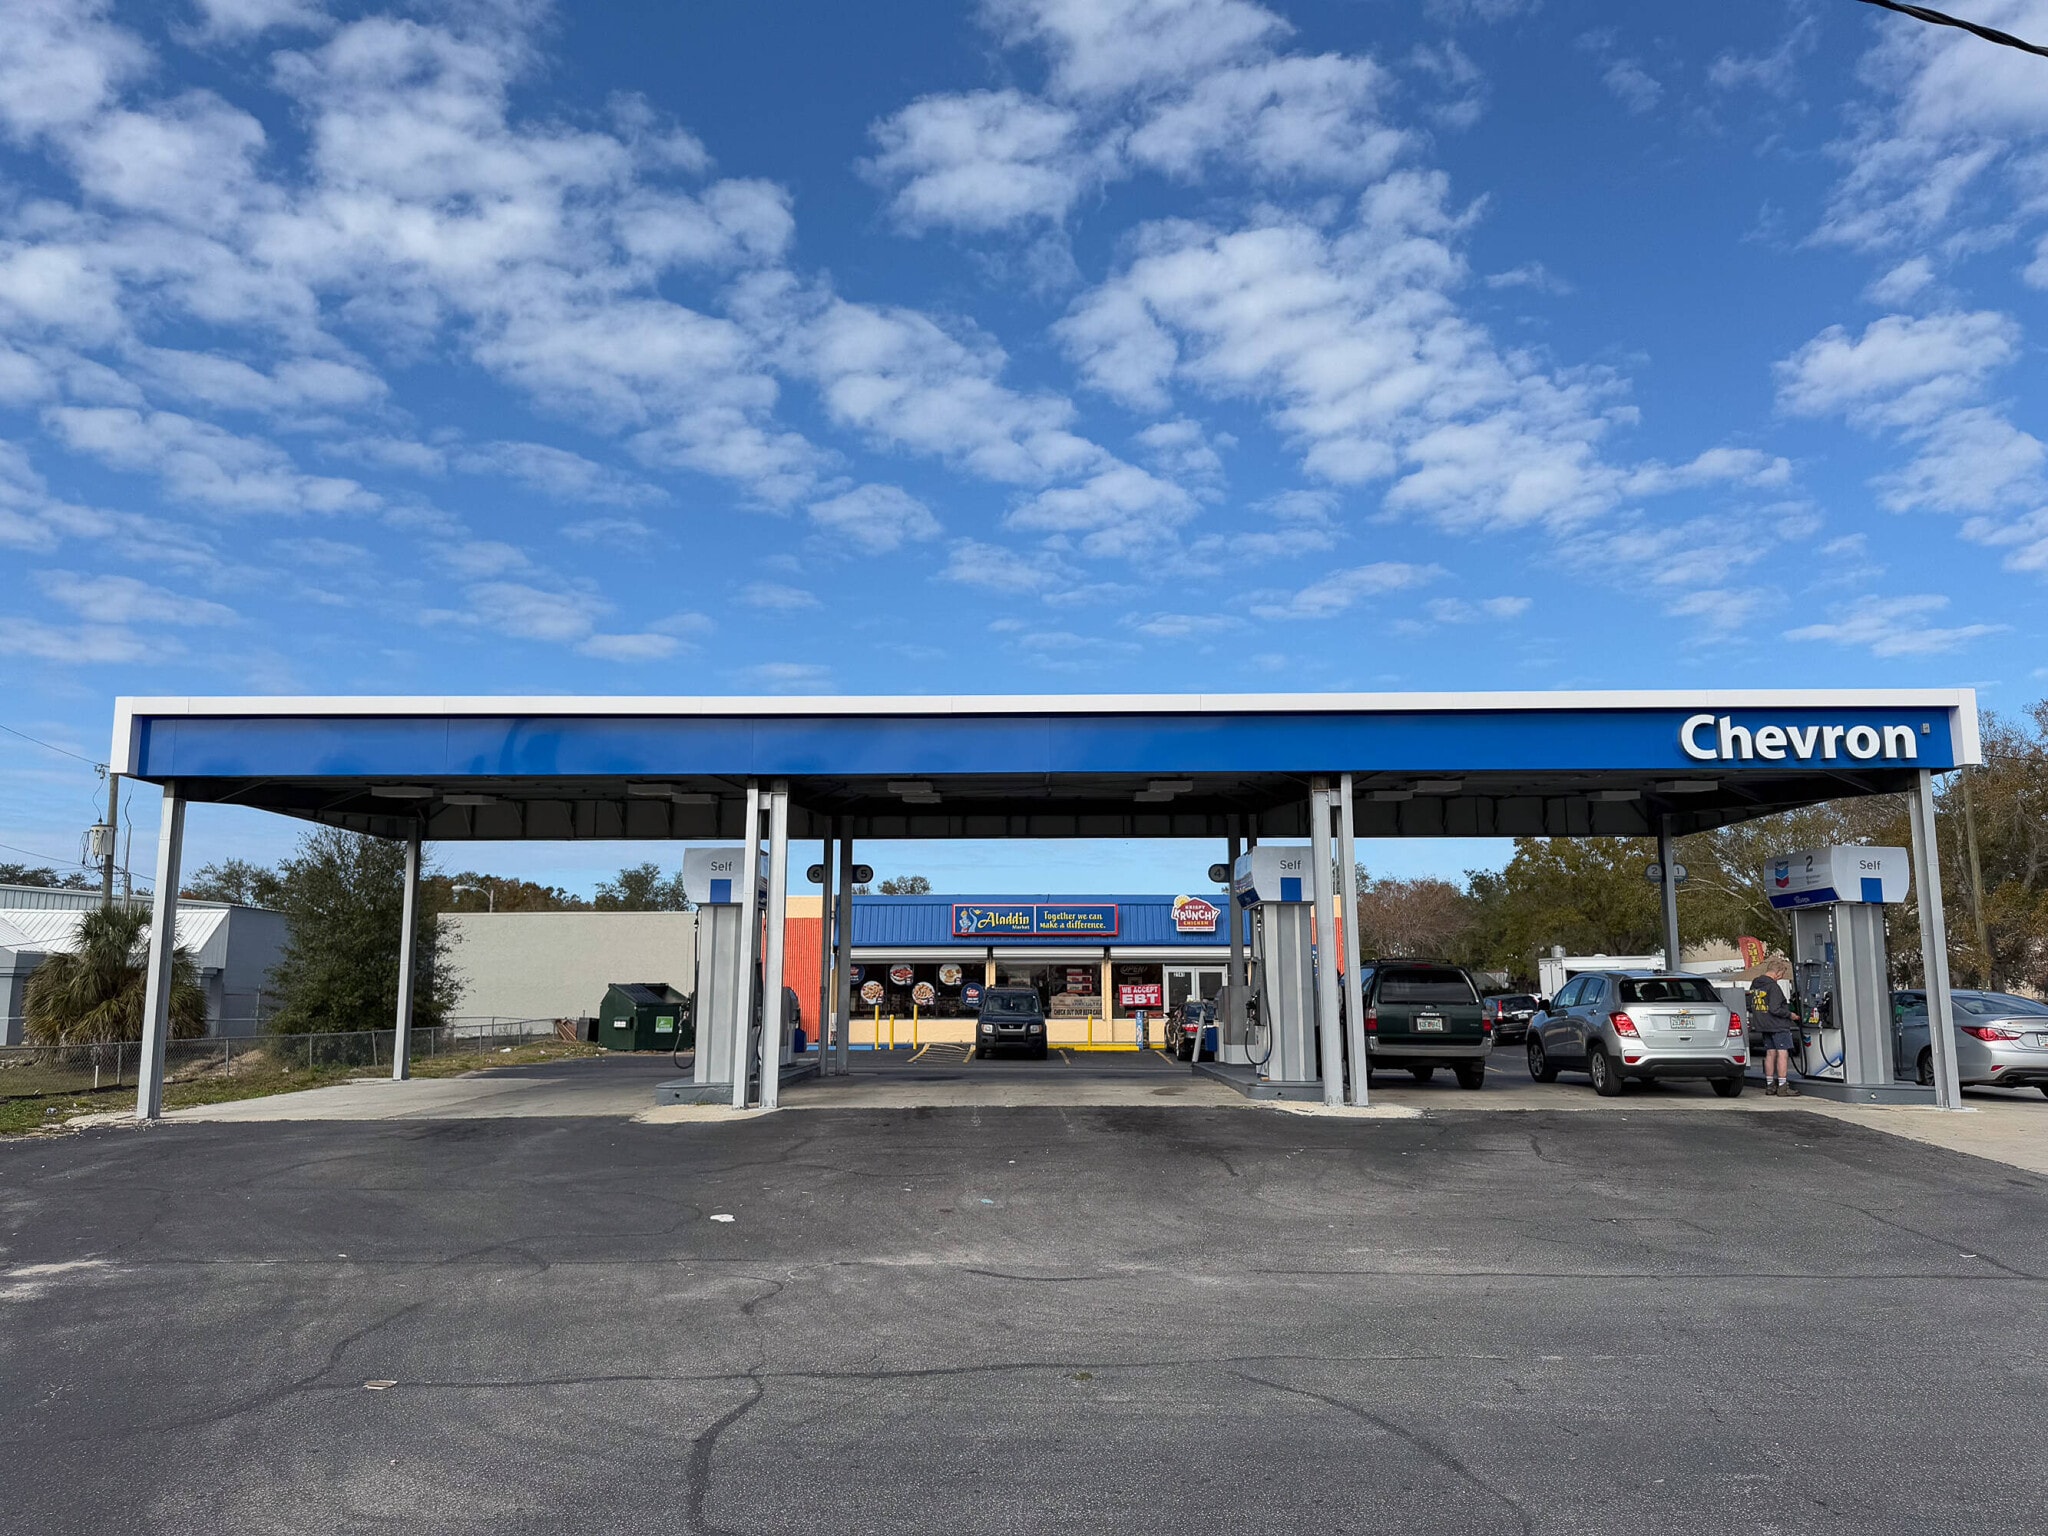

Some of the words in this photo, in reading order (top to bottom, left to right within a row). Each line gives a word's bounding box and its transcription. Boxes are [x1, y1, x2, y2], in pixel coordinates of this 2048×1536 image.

[1680, 714, 1918, 760] Chevron
[710, 861, 733, 871] Self
[1279, 859, 1302, 870] Self
[1805, 855, 1814, 873] 2
[1859, 859, 1882, 871] Self
[812, 869, 820, 878] 6
[860, 869, 868, 878] 5
[1214, 868, 1221, 877] 4
[1651, 866, 1658, 875] 2
[1043, 910, 1077, 922] Together
[1173, 907, 1218, 921] KRUNCHY
[977, 911, 1030, 929] Aladdin
[1066, 919, 1106, 929] difference.
[1121, 986, 1132, 994] WE
[1133, 985, 1158, 993] ACCEPT
[1121, 993, 1159, 1005] EBT
